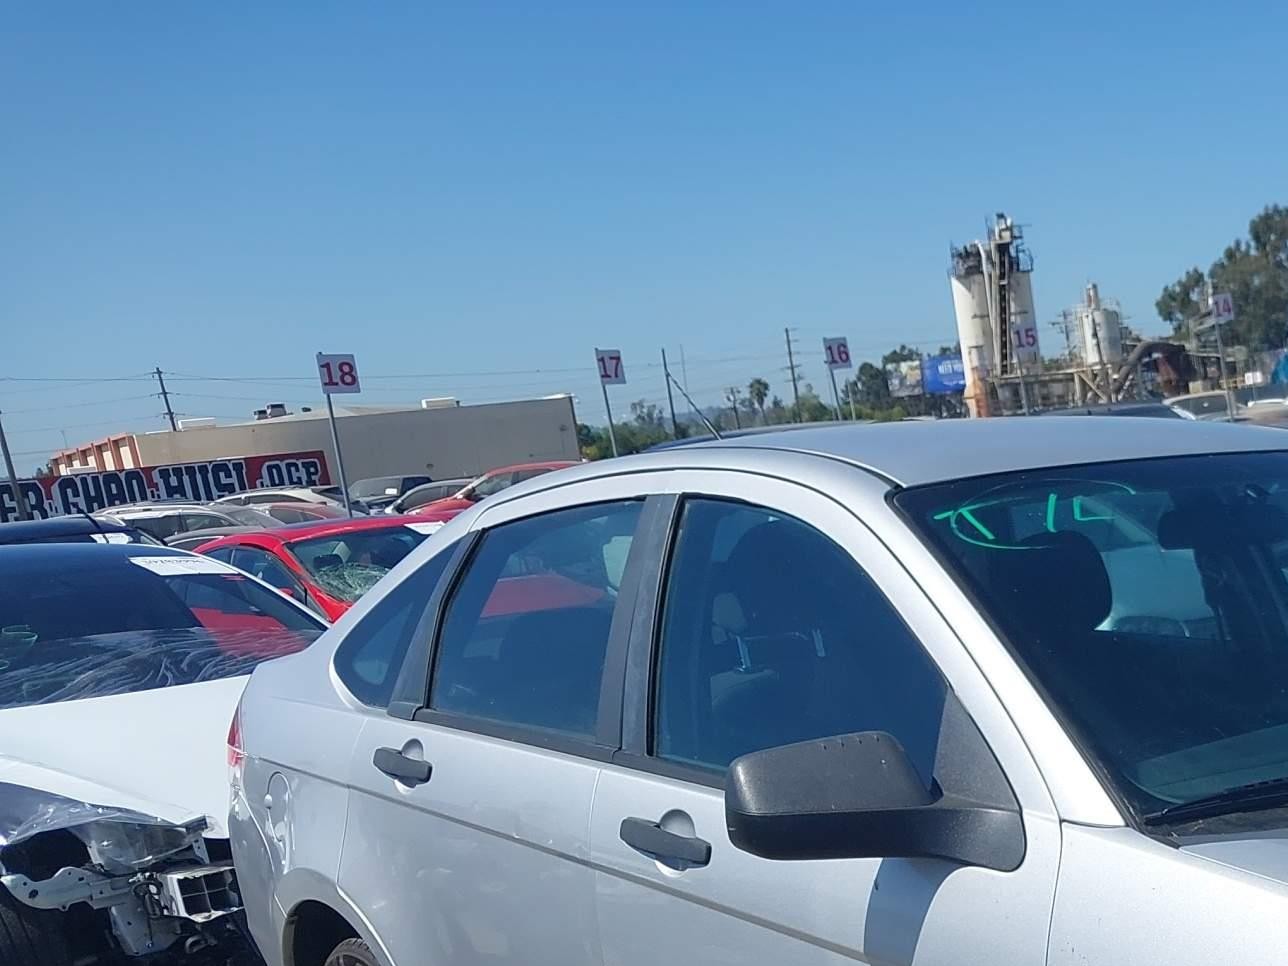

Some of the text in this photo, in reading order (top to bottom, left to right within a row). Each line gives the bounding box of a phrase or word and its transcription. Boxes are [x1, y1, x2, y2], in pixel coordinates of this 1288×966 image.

[1014, 328, 1036, 348] 15
[826, 343, 849, 364] 16
[320, 361, 357, 386] 18
[597, 356, 621, 378] 17
